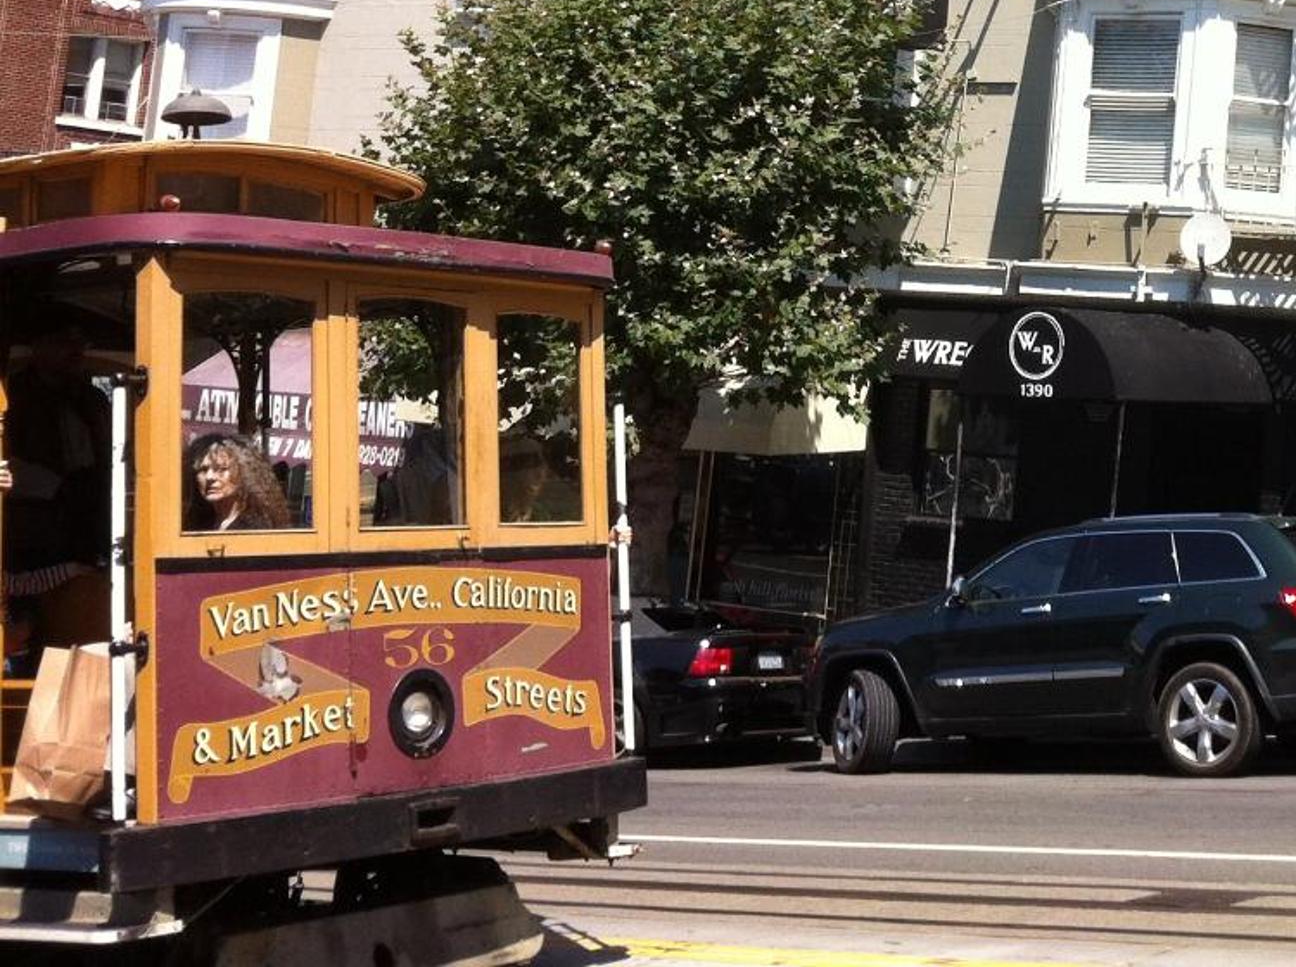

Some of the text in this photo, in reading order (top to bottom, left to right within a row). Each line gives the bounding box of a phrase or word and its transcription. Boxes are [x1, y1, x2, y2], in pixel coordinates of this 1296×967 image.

[896, 337, 912, 363] THE
[1019, 383, 1054, 398] 1390
[305, 397, 415, 440] CEANERS
[208, 601, 270, 639] Van
[276, 589, 358, 626] Ness
[453, 576, 577, 615] California
[383, 628, 455, 668] 56
[485, 675, 587, 715] Streets
[192, 696, 356, 765] & Market
